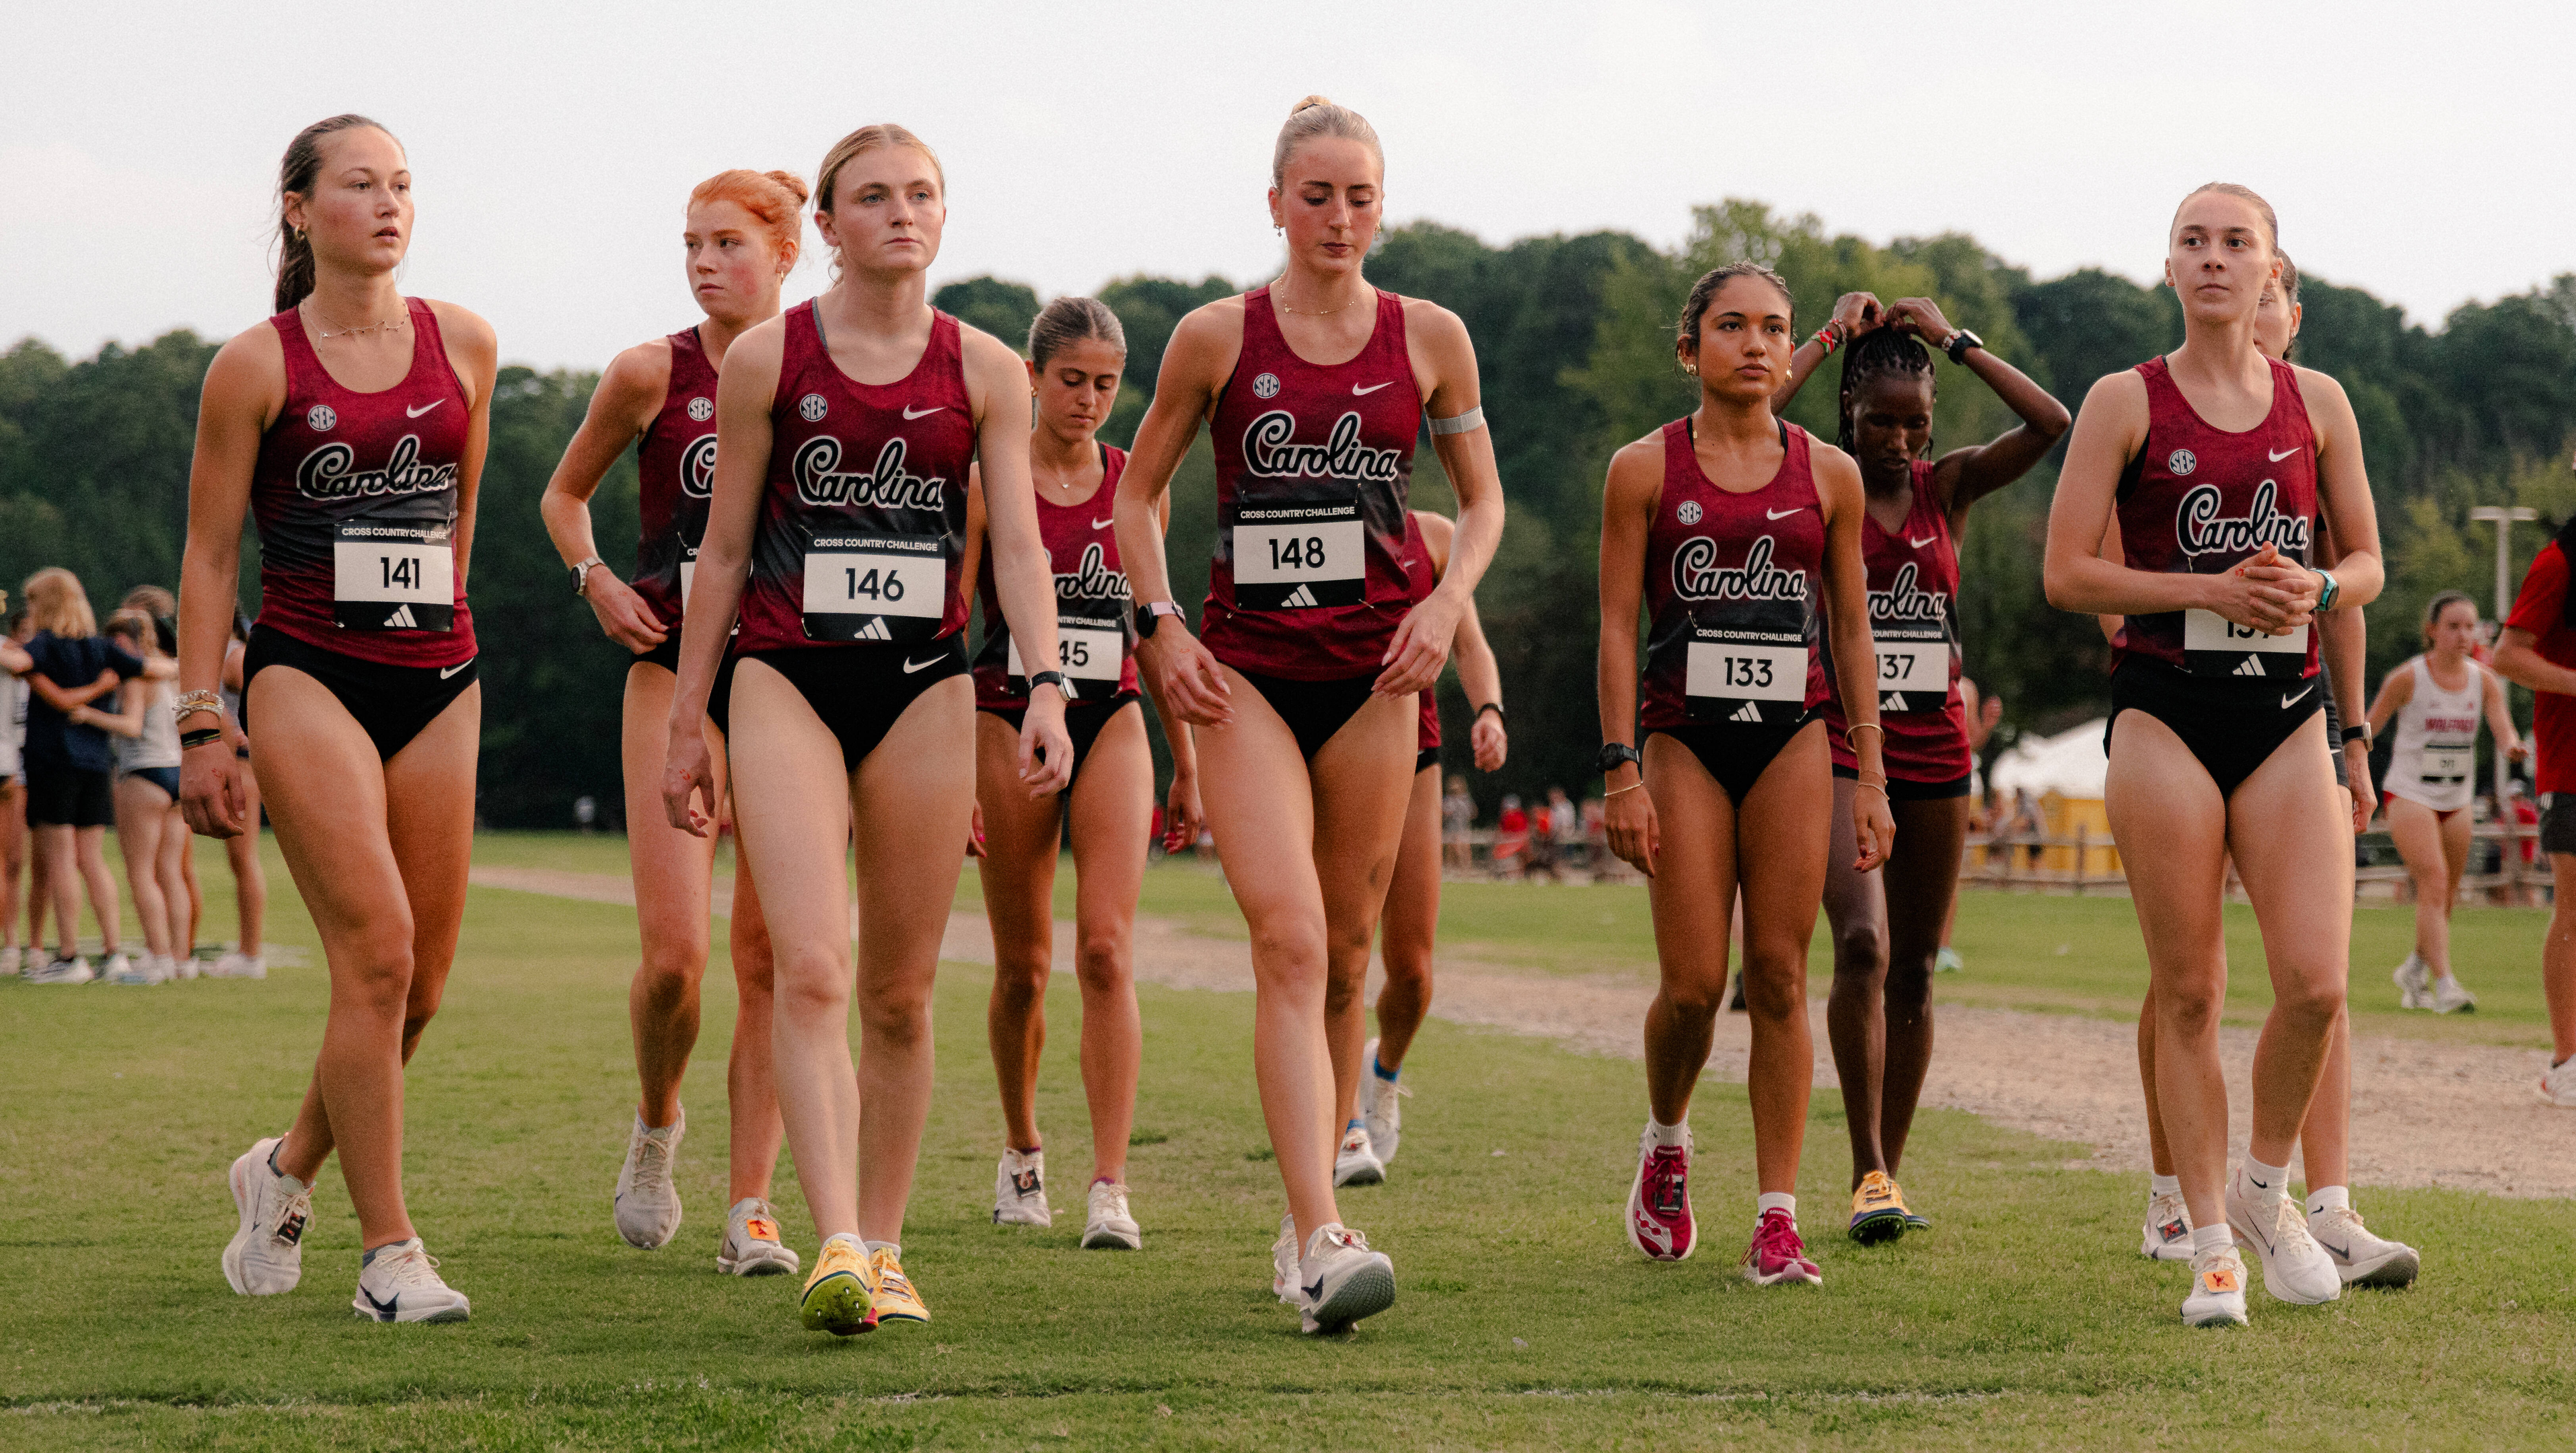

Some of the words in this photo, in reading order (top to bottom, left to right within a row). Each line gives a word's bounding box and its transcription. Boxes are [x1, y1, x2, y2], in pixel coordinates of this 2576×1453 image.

[1255, 374, 1278, 397] SEC
[309, 406, 336, 430] SEC
[689, 399, 712, 419] SEC
[801, 396, 826, 420] SEC
[1243, 410, 1401, 481] Carolina
[296, 434, 457, 500] Carolina
[793, 435, 946, 511] Carolina
[2170, 450, 2195, 474] SEC
[1241, 511, 1265, 519] CROSS
[1266, 509, 1304, 518] COUNTRY
[1305, 507, 1355, 517] CHALLENGE
[1679, 502, 1701, 524] SEC
[2176, 479, 2309, 556] Carolina
[342, 528, 371, 536] CROSS
[372, 528, 410, 537] COUNTRY
[410, 529, 446, 539] CHALLENGE
[813, 538, 844, 548] CROSS
[844, 539, 887, 550] COUNTRY
[887, 539, 938, 552] CHALLENGE
[1269, 537, 1325, 570] 148
[380, 557, 419, 589] 141
[1052, 542, 1133, 600] rolina
[1672, 535, 1808, 601] Carolina
[846, 568, 904, 602] 146
[1866, 561, 1948, 620] rolina
[1057, 616, 1076, 624] NTRY
[1076, 617, 1117, 627] CHALLENGE
[1697, 629, 1723, 638] CROSS
[1724, 630, 1760, 640] COUNTRY
[1760, 632, 1802, 642] CHALLENGE
[1902, 630, 1942, 638] CHALLENGE
[1059, 640, 1089, 667] 45
[1724, 657, 1773, 687] 133
[1769, 1209, 1791, 1220] saucony
